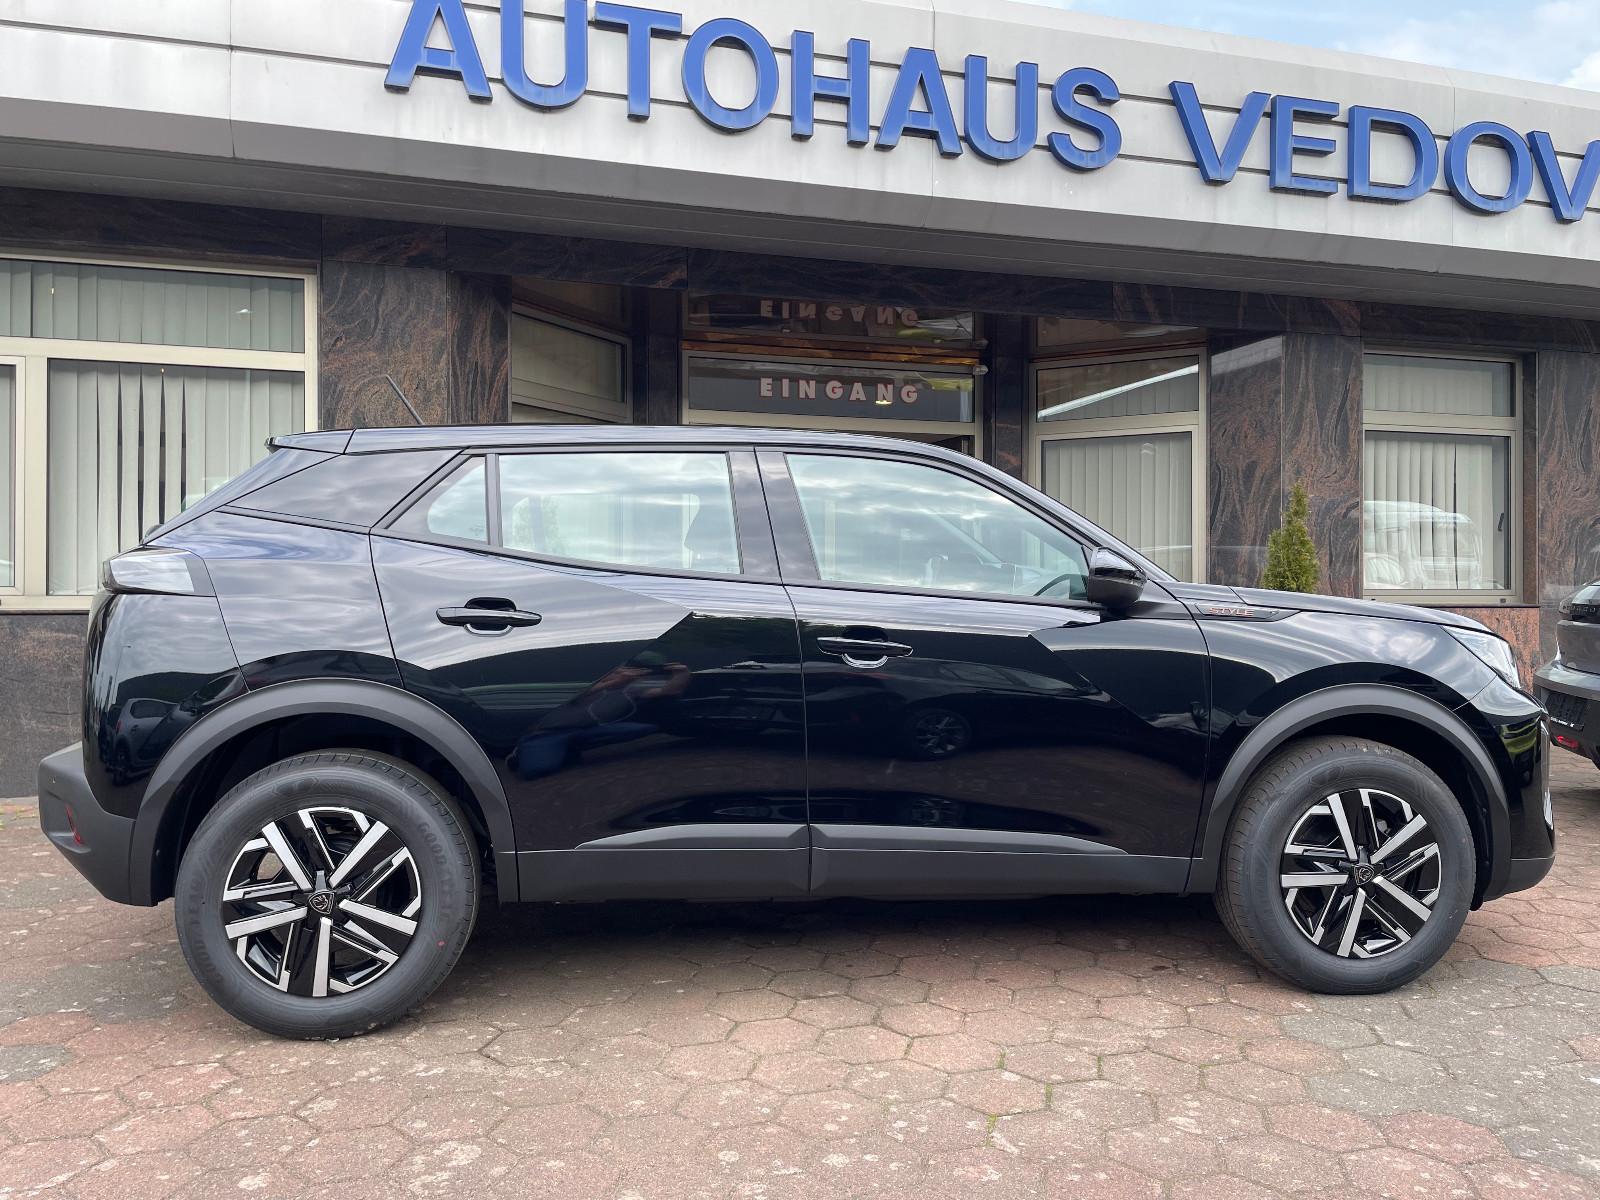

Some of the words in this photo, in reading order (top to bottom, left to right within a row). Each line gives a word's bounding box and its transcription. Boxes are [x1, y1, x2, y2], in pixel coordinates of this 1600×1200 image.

[385, 0, 1122, 171] AUTOHAUS
[1169, 80, 1600, 223] VEDOV
[760, 377, 918, 403] EINGANG
[1208, 607, 1254, 616] STYLE
